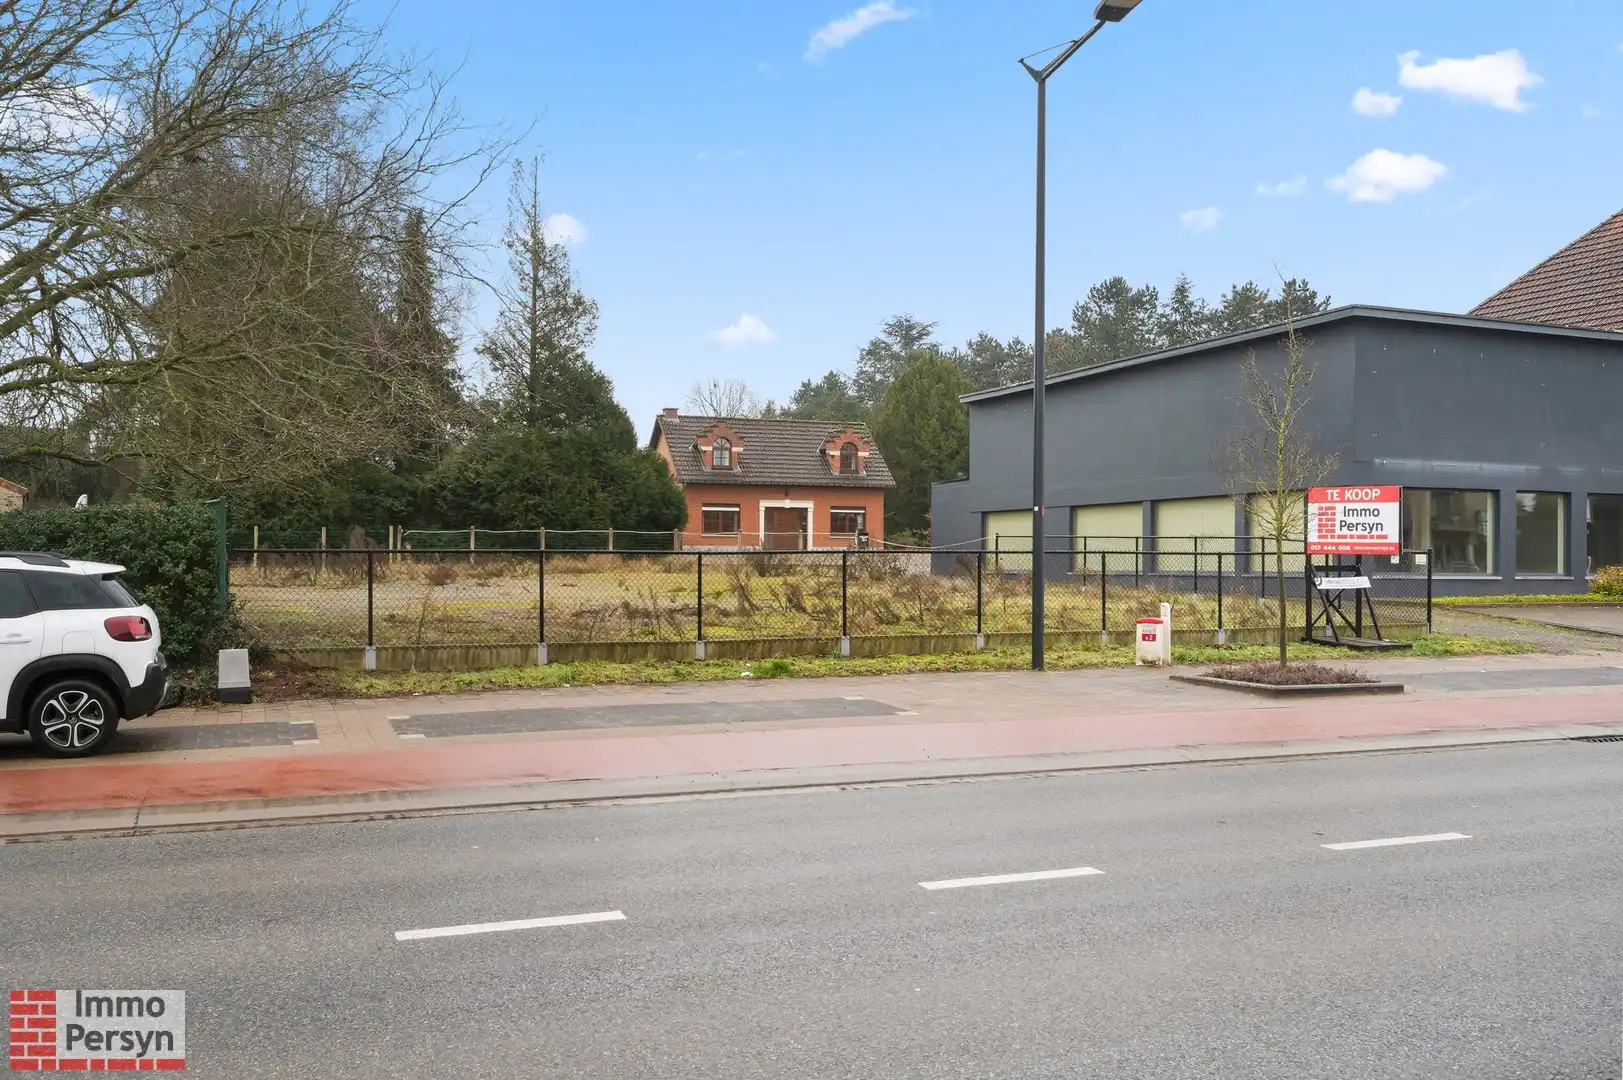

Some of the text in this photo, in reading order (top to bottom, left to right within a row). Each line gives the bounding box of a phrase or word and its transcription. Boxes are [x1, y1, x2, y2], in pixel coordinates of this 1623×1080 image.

[1326, 489, 1381, 501] TE KOOP
[1343, 506, 1380, 517] Immo
[1339, 520, 1383, 534] Persyn
